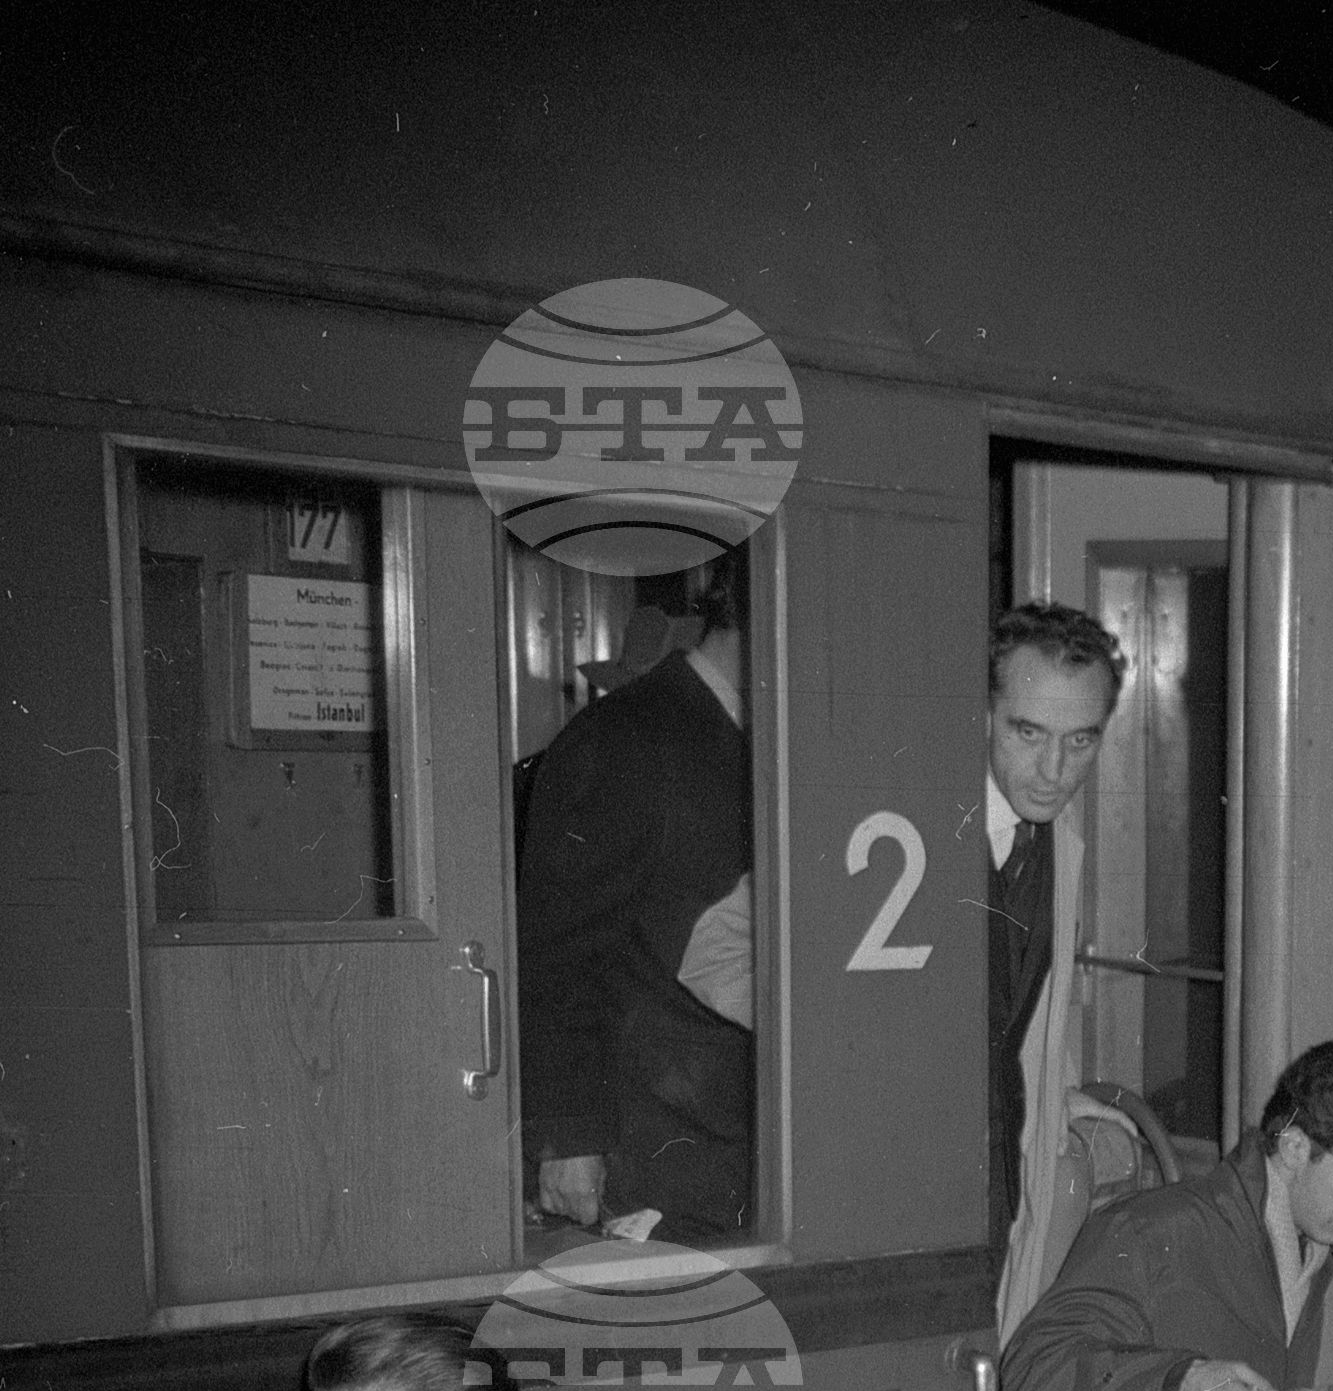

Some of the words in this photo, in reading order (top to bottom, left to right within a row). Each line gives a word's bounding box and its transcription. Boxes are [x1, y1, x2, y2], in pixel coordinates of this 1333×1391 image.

[296, 588, 351, 607] München
[317, 701, 366, 722] Istanbul
[846, 811, 934, 970] 2
